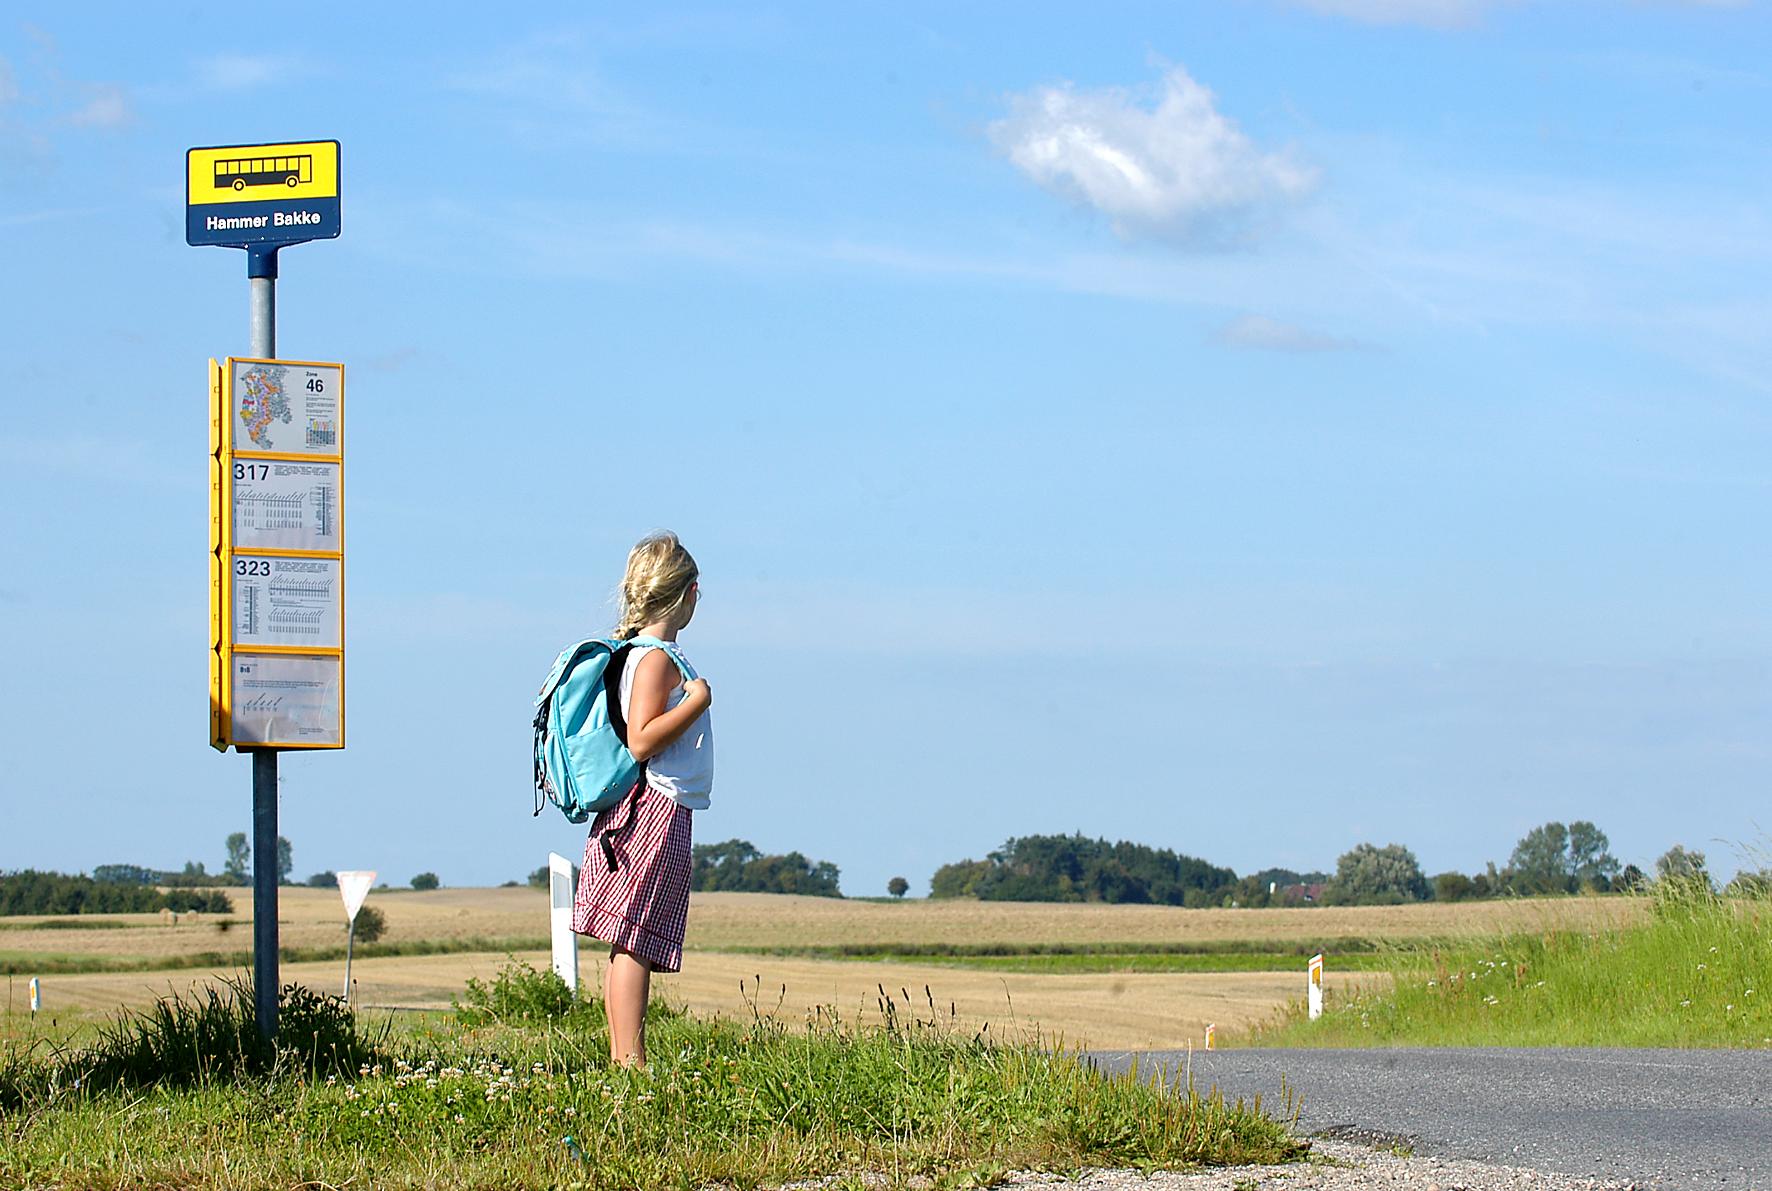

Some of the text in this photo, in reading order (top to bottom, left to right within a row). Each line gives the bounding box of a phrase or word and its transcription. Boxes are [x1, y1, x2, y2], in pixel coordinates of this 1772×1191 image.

[207, 211, 321, 230] Hammer Bakke
[306, 379, 324, 392] 46
[234, 463, 269, 480] 317
[236, 560, 270, 576] 323
